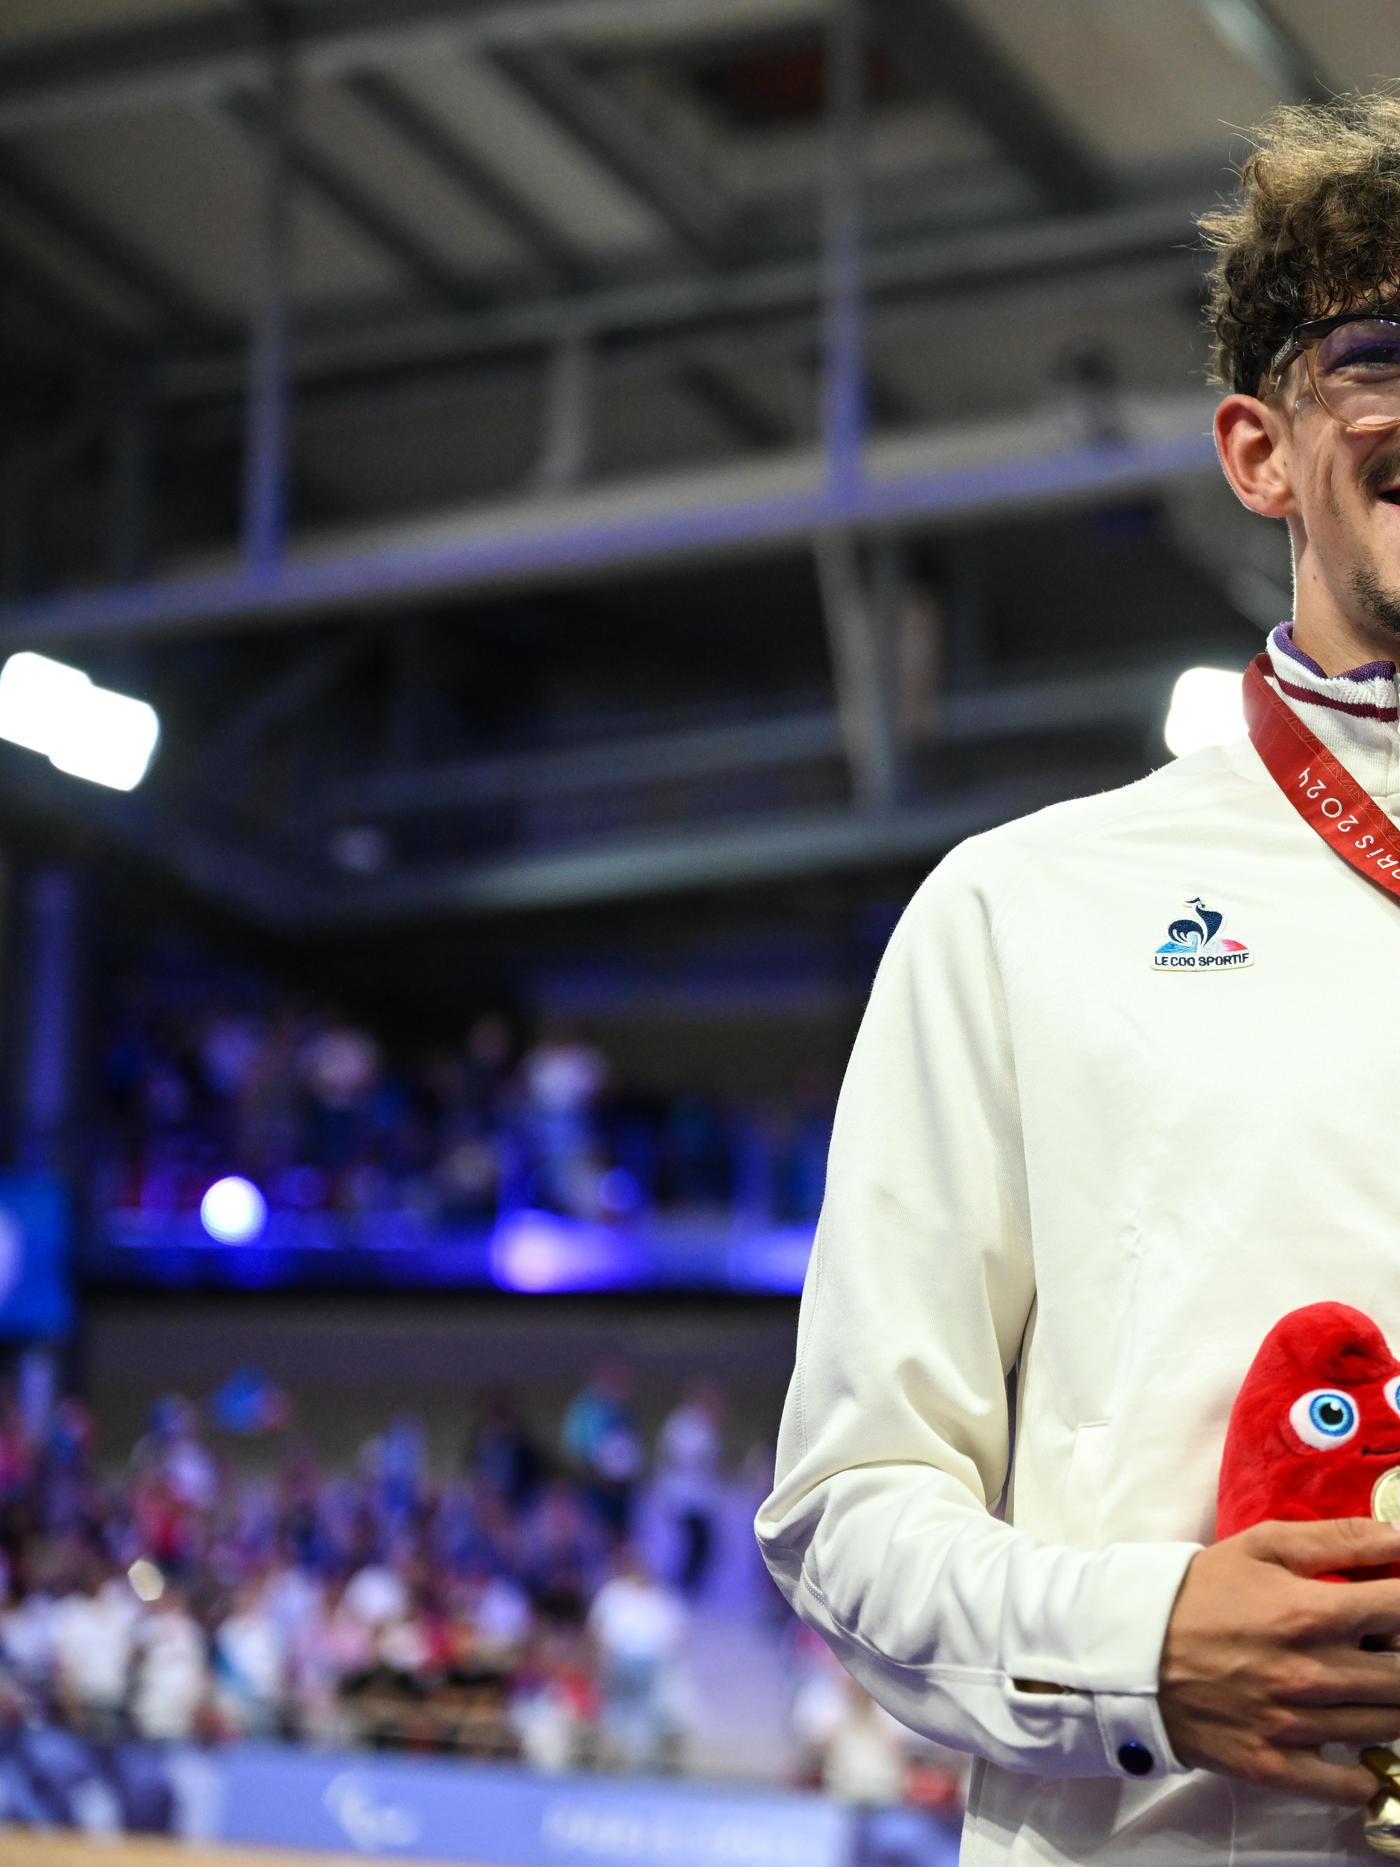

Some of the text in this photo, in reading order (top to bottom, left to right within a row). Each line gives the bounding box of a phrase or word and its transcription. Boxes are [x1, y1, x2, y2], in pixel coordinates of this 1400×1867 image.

[1298, 767, 1360, 833] 2024
[1154, 952, 1250, 968] LE COQ SPORTIF
